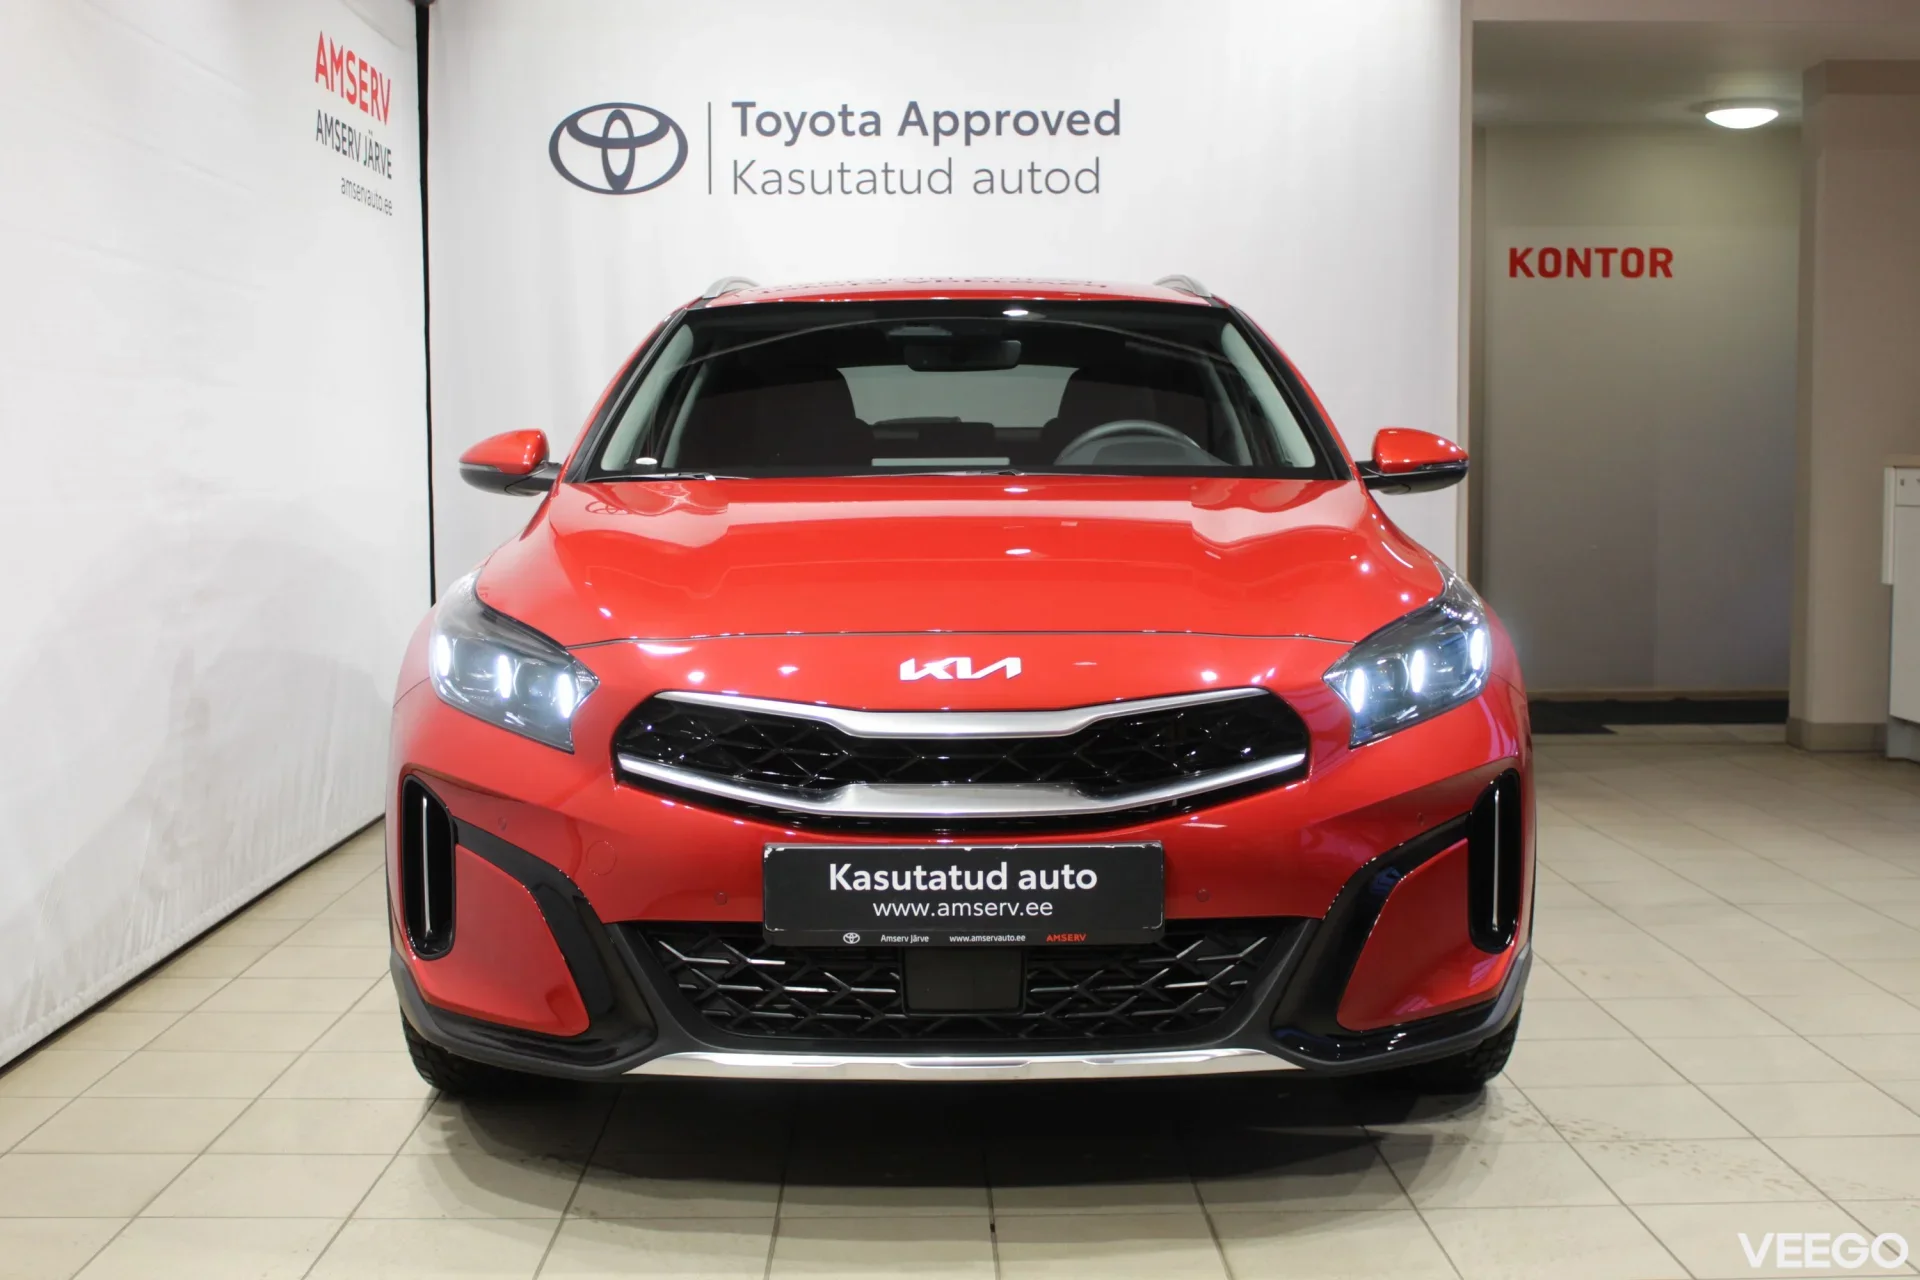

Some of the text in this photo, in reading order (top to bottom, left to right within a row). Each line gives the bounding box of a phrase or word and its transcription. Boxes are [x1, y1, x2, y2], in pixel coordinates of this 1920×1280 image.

[315, 30, 391, 125] AMSERV
[732, 98, 1122, 146] Toyota Approved
[316, 109, 392, 180] AMSERV JÄRVE
[733, 157, 1101, 195] Kasutatud autod
[341, 176, 393, 216] amservauto.ee
[1509, 247, 1674, 278] KONTOR
[900, 656, 1022, 680] KIA
[829, 861, 1098, 891] Kasutatud auto
[873, 901, 1054, 917] www.amserv.ee
[880, 933, 930, 943] Amserv Järve
[949, 933, 1026, 943] www.amservauto.ee
[1046, 933, 1087, 943] AMSERV
